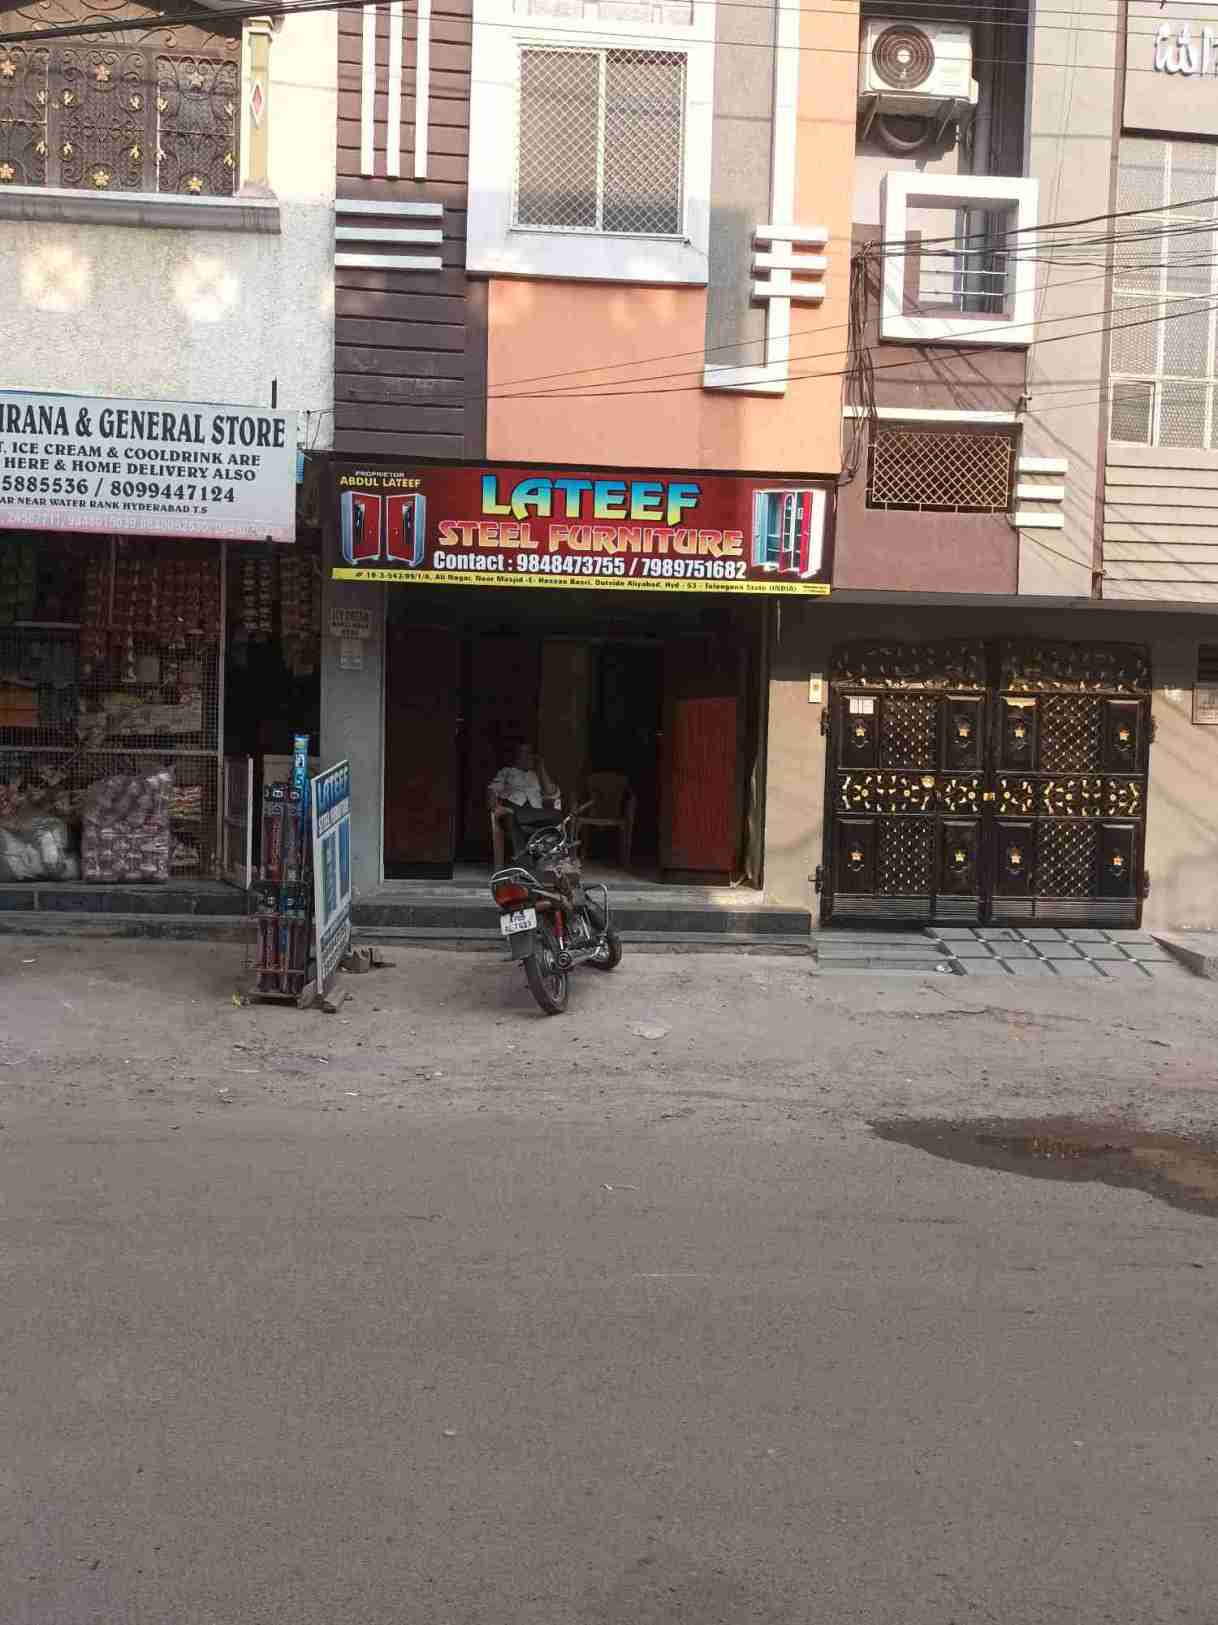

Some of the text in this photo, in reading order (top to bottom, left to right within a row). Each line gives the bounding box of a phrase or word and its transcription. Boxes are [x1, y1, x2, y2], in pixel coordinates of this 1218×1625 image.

[0, 403, 286, 448] IRANA & GENERAL STORE
[12, 441, 39, 454] ICE
[44, 443, 103, 458] CREAM
[107, 446, 119, 459] &
[124, 447, 223, 464] COOLDRINK
[227, 454, 261, 467] ARE
[4, 457, 256, 481] HERE & HOME DELIVERY ALSO
[340, 476, 421, 489] ABDUL LATEEF
[2, 475, 236, 503] 5885536 / 8099447124
[480, 474, 701, 526] LATEEF
[17, 496, 47, 506] NEAR
[49, 498, 86, 508] WATER
[122, 502, 190, 513] HYDERABAD
[438, 519, 744, 558] STEEL FURNITURE
[433, 550, 504, 570] Contact
[516, 553, 625, 576] 9848473755
[627, 556, 637, 577] /
[641, 558, 747, 580] 7989751682
